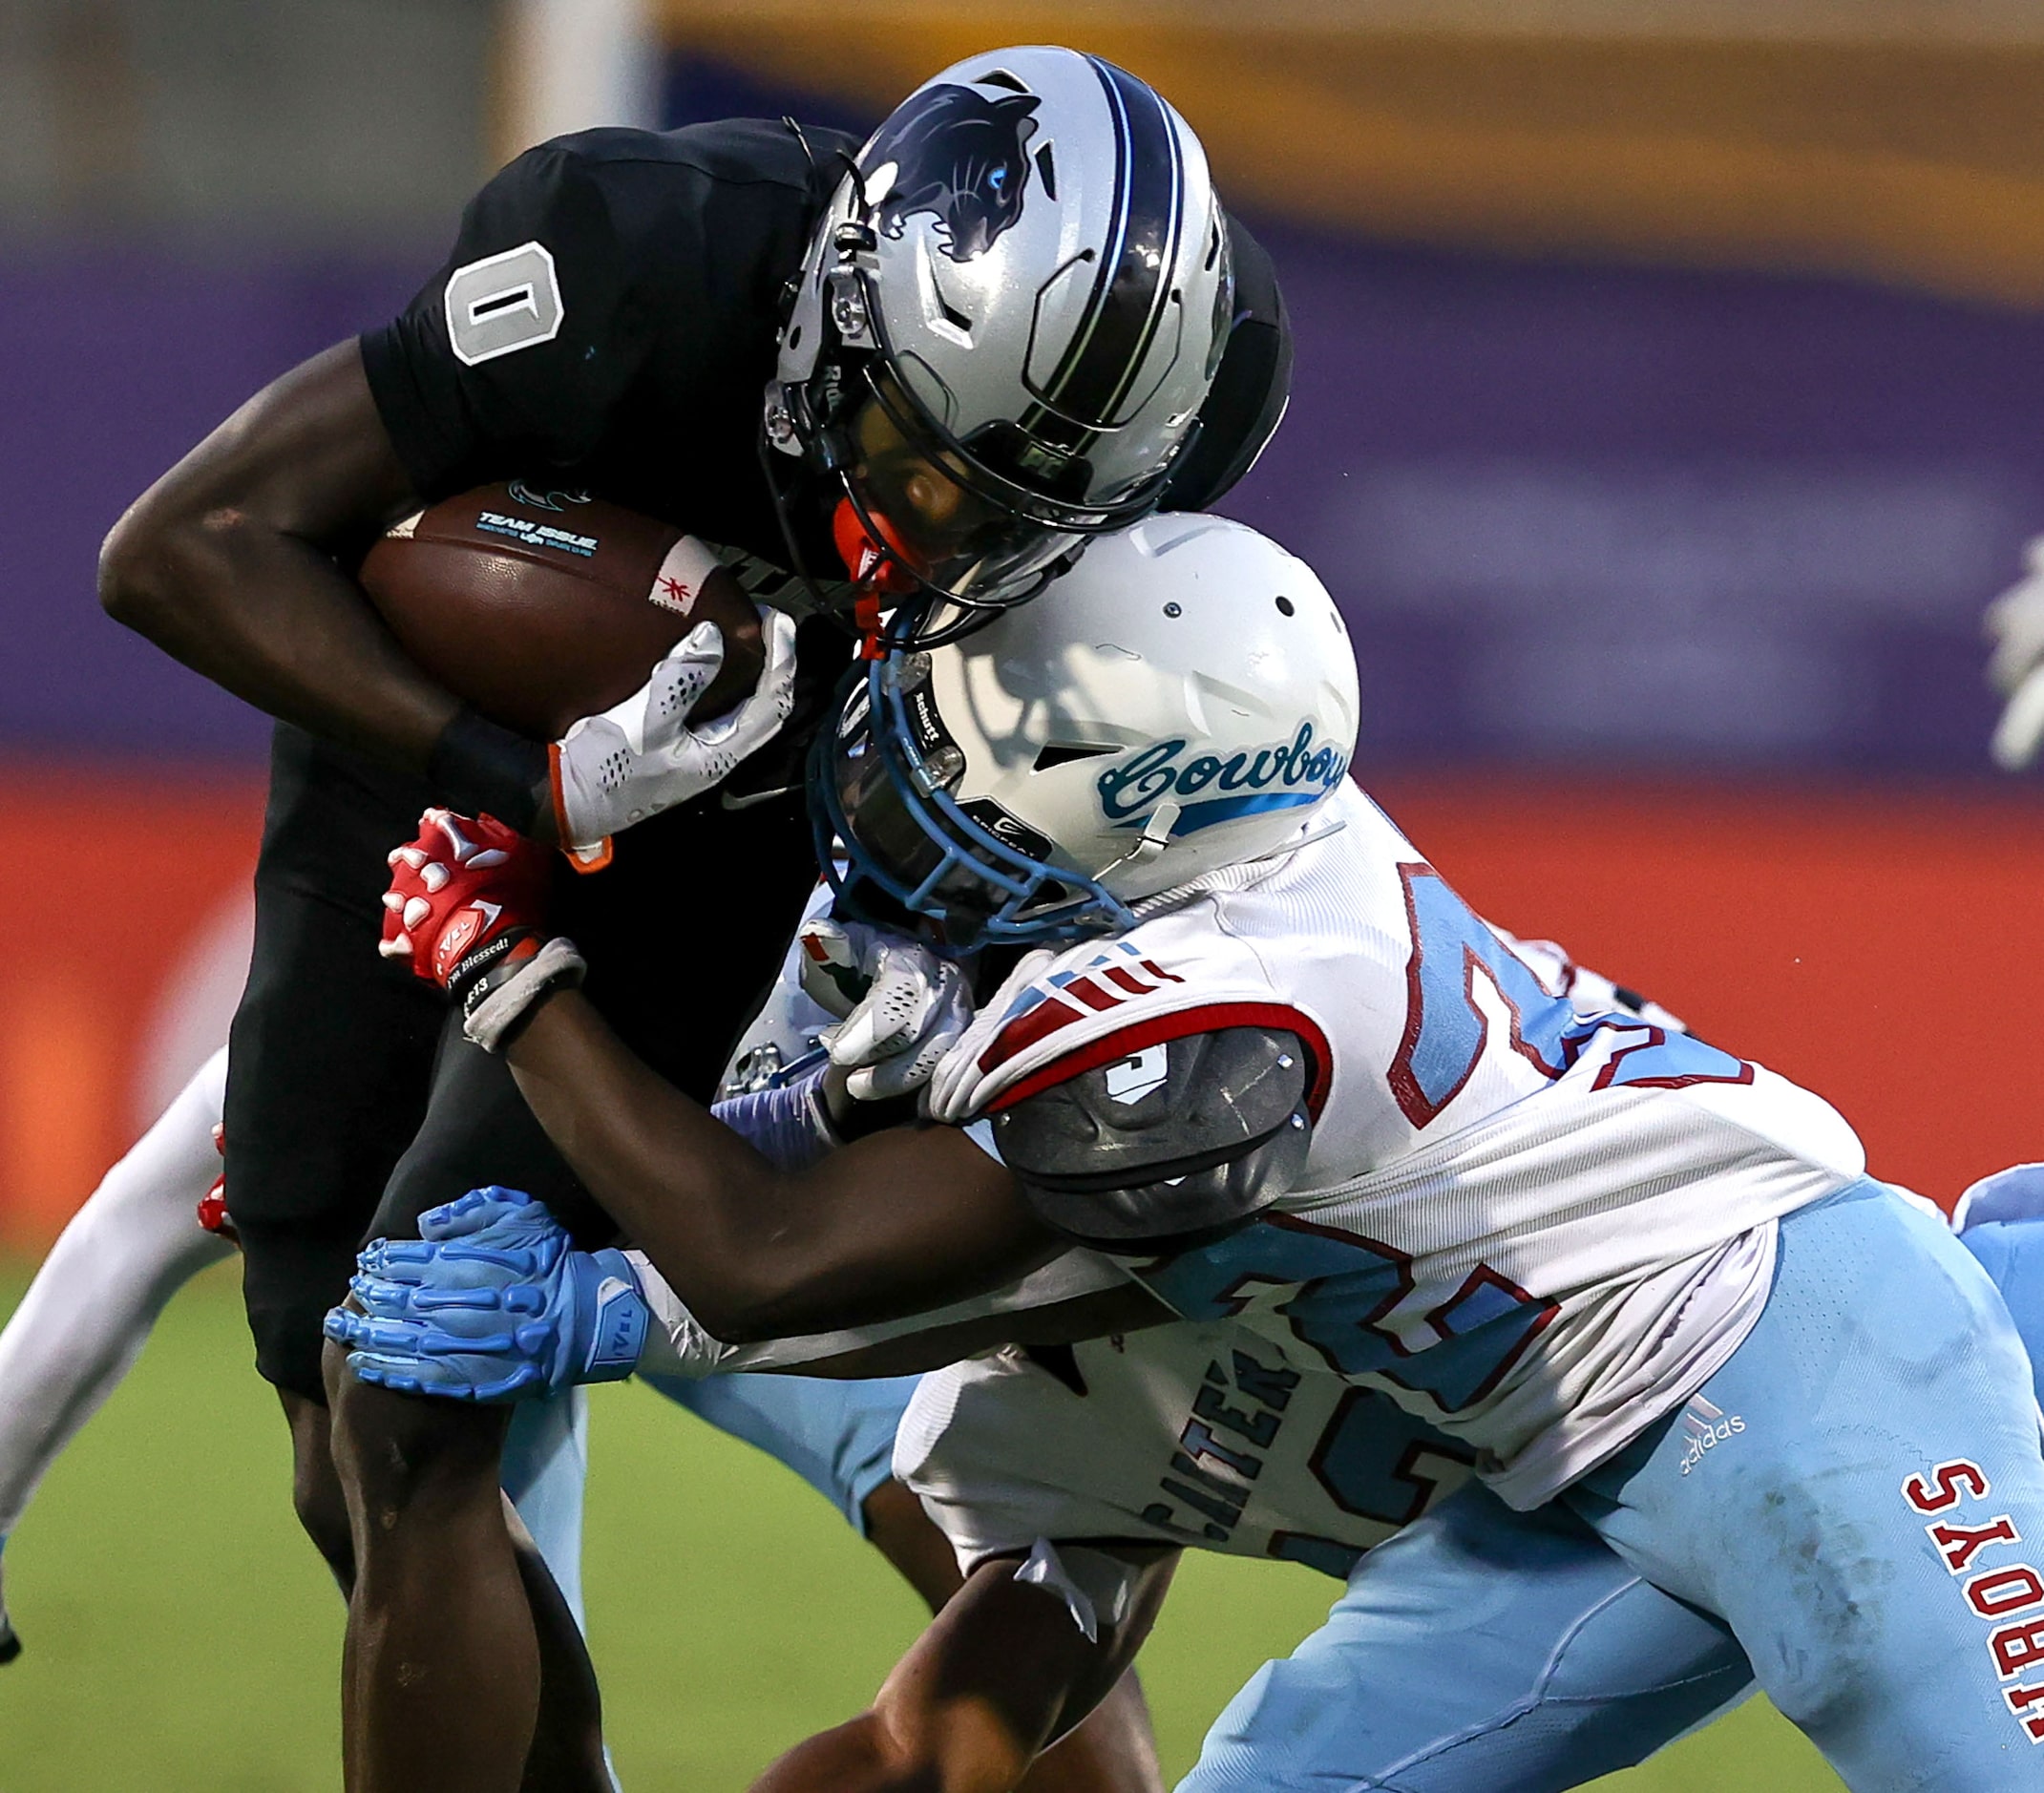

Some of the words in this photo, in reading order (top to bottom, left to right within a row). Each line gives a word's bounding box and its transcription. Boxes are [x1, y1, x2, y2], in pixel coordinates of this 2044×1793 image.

[445, 241, 564, 367] 0
[479, 511, 536, 533] TEAM
[461, 938, 510, 974] Blessed!
[1680, 1416, 1746, 1475] adidas
[1900, 1457, 2044, 1745] BOYS
